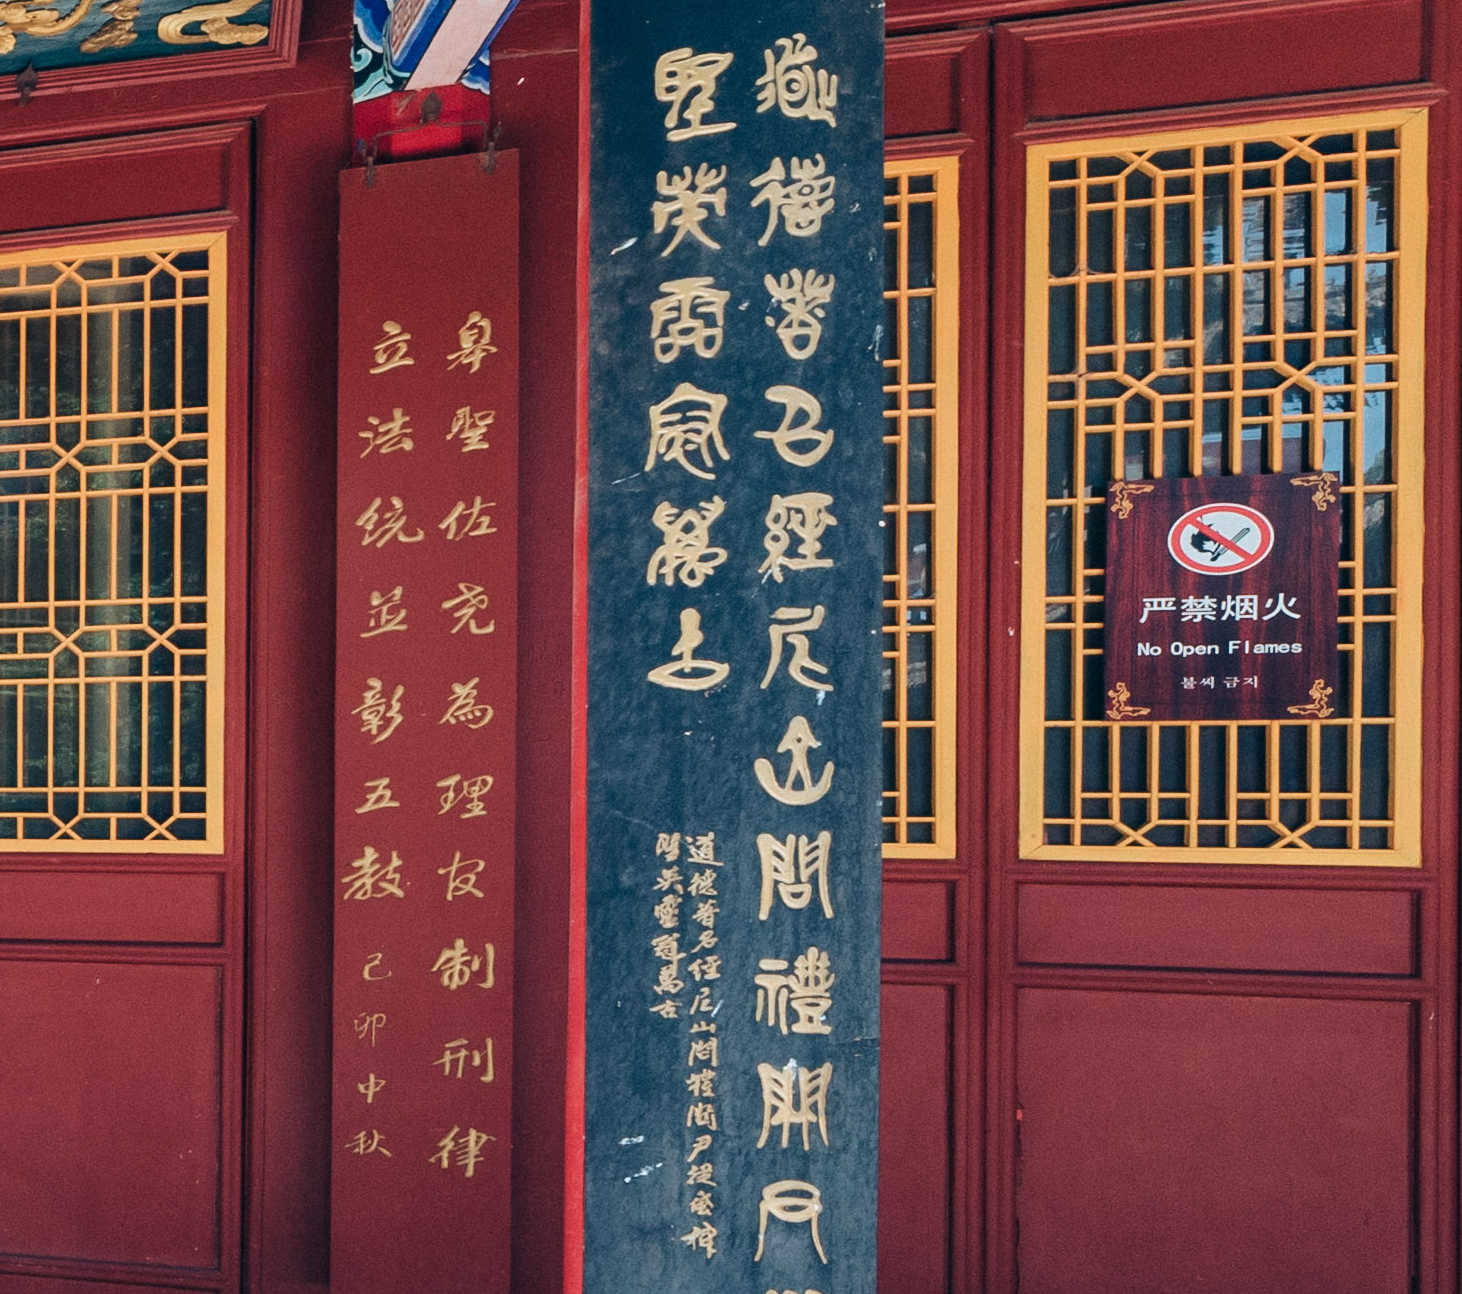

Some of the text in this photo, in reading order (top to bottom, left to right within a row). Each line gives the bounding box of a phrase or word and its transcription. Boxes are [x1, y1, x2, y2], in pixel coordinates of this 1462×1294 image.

[1139, 592, 1302, 624] 严禁烟火
[1136, 639, 1303, 657] No Open Flames
[1180, 674, 1259, 690] 불씨 금지
